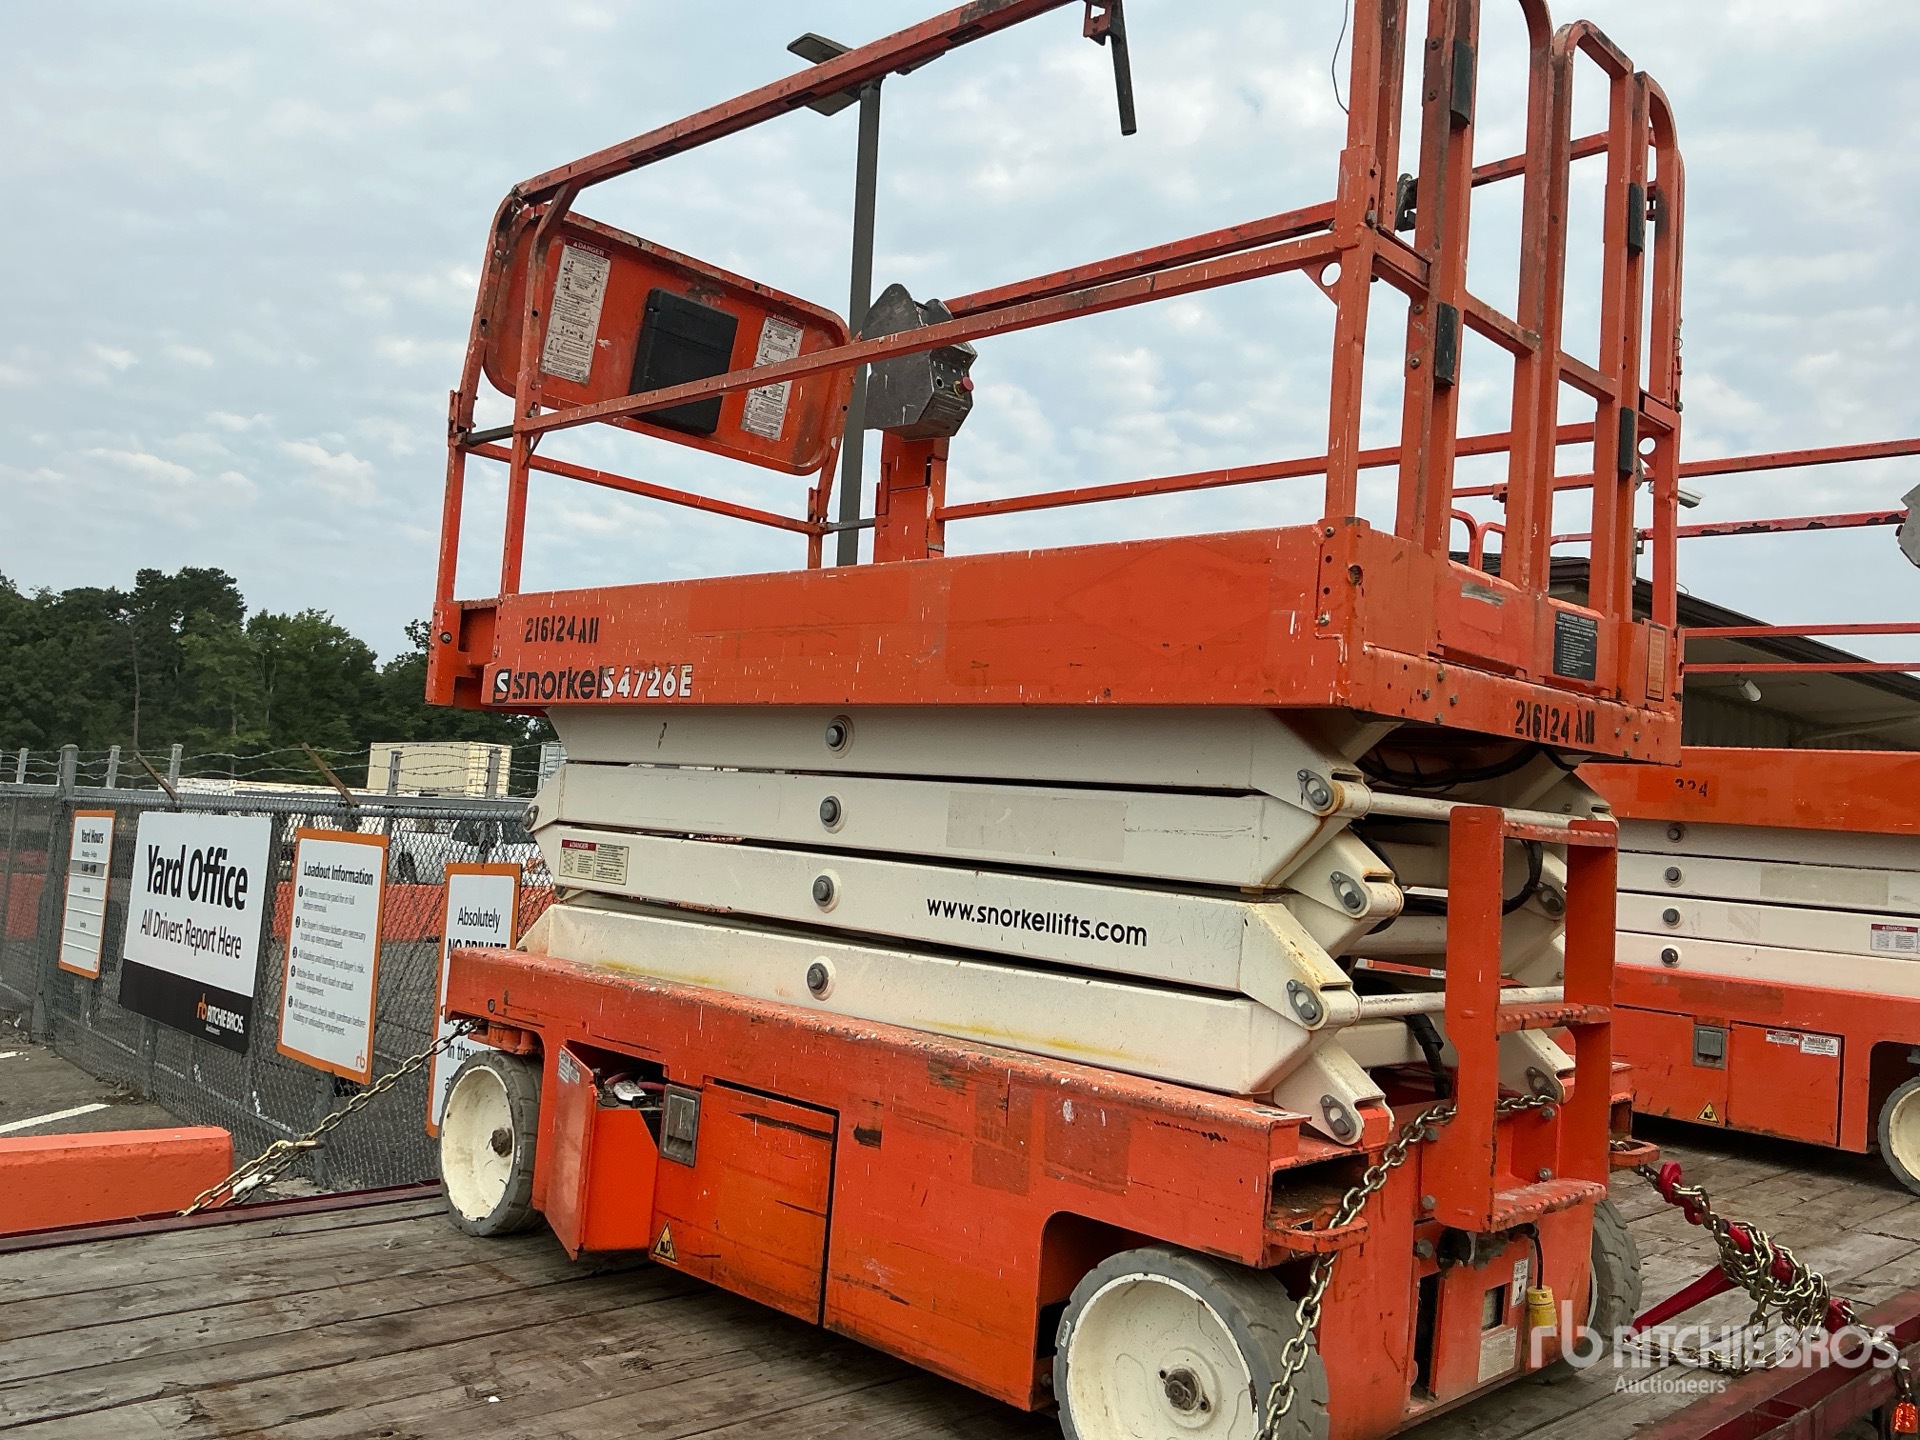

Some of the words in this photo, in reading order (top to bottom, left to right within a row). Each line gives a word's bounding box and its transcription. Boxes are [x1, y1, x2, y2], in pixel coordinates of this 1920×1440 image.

[577, 242, 605, 257] DANGER
[512, 666, 603, 700] snorkel
[146, 844, 187, 899] Yard
[187, 846, 249, 911] Office
[303, 860, 331, 880] Loadout
[331, 864, 374, 886] Information
[140, 908, 153, 936] All
[153, 911, 183, 945] Drivers
[184, 918, 217, 957] Report
[217, 925, 242, 960] Here
[457, 906, 501, 934] Absolutely
[926, 898, 1148, 947] www.snorkellifts.com
[196, 992, 207, 1020] rb
[457, 1041, 471, 1062] the
